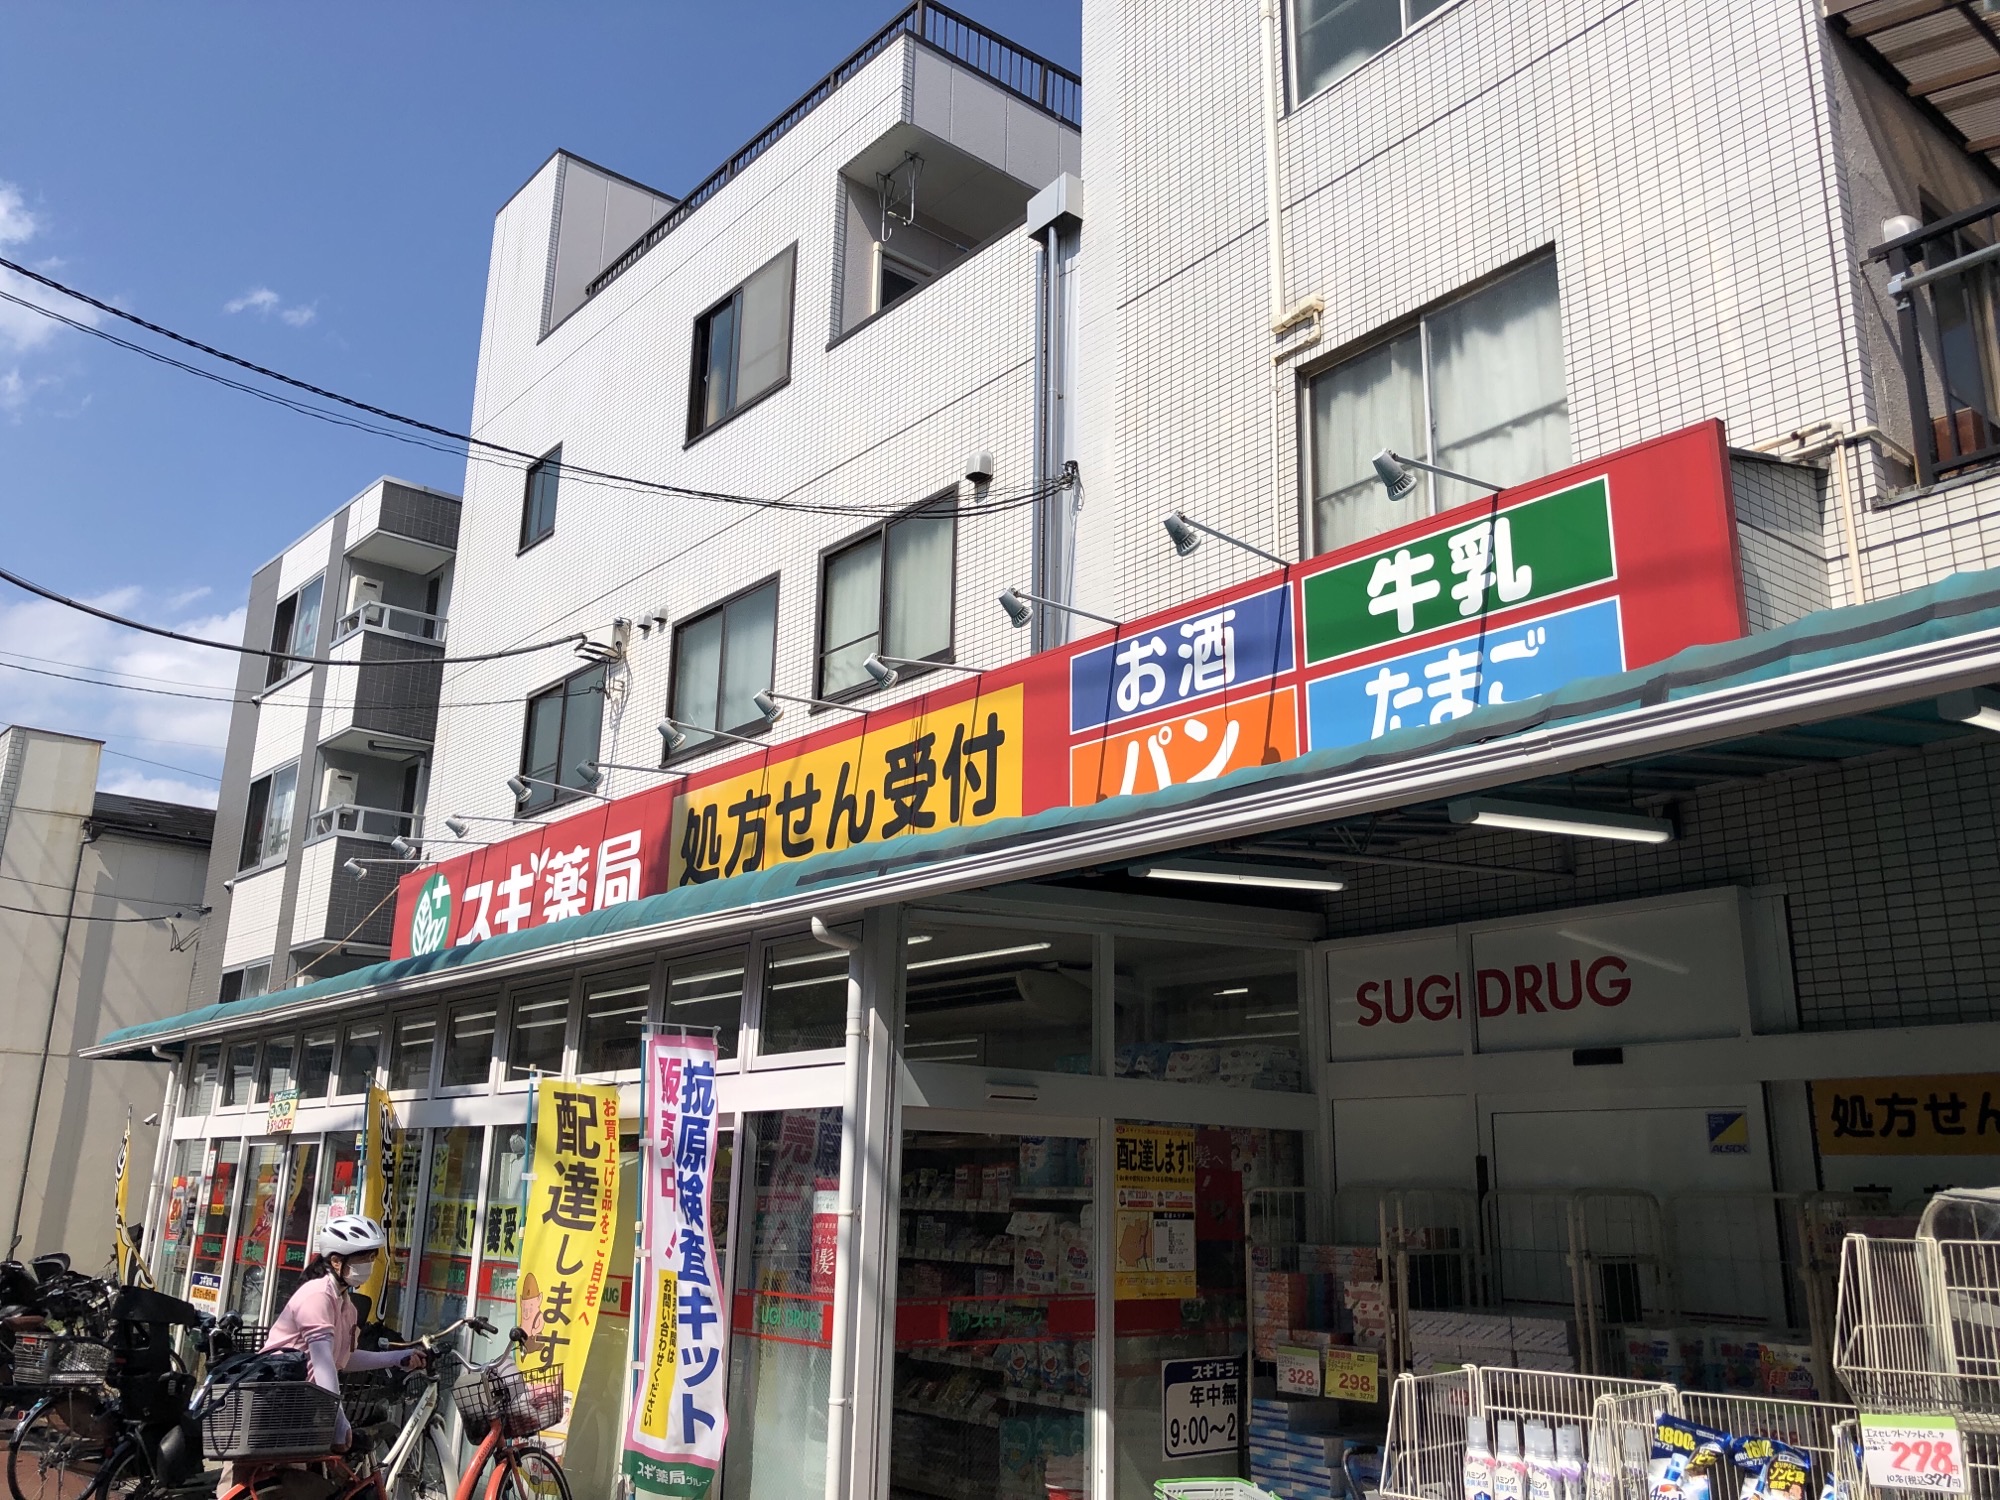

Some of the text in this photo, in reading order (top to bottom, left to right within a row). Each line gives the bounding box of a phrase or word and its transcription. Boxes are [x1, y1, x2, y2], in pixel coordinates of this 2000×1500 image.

[1366, 516, 1532, 634] 牛乳
[1116, 609, 1236, 713] お酒
[1364, 627, 1546, 741] たまご
[679, 713, 1005, 887] 処方せん受付
[1119, 719, 1241, 796] パン
[457, 829, 643, 944] スギ薬局
[1356, 955, 1632, 1027] SUGI DRUG
[1710, 1144, 1747, 1154] ALSOK
[541, 1090, 601, 1373] 配達します
[676, 1059, 719, 1444] 抗原検査キット
[644, 1278, 672, 1427] お問い合わせください
[1189, 1383, 1239, 1409] 年中無
[637, 1461, 710, 1488] スギ薬局グルー
[1466, 1470, 1487, 1480] ハミング
[1495, 1475, 1516, 1485] ハミング
